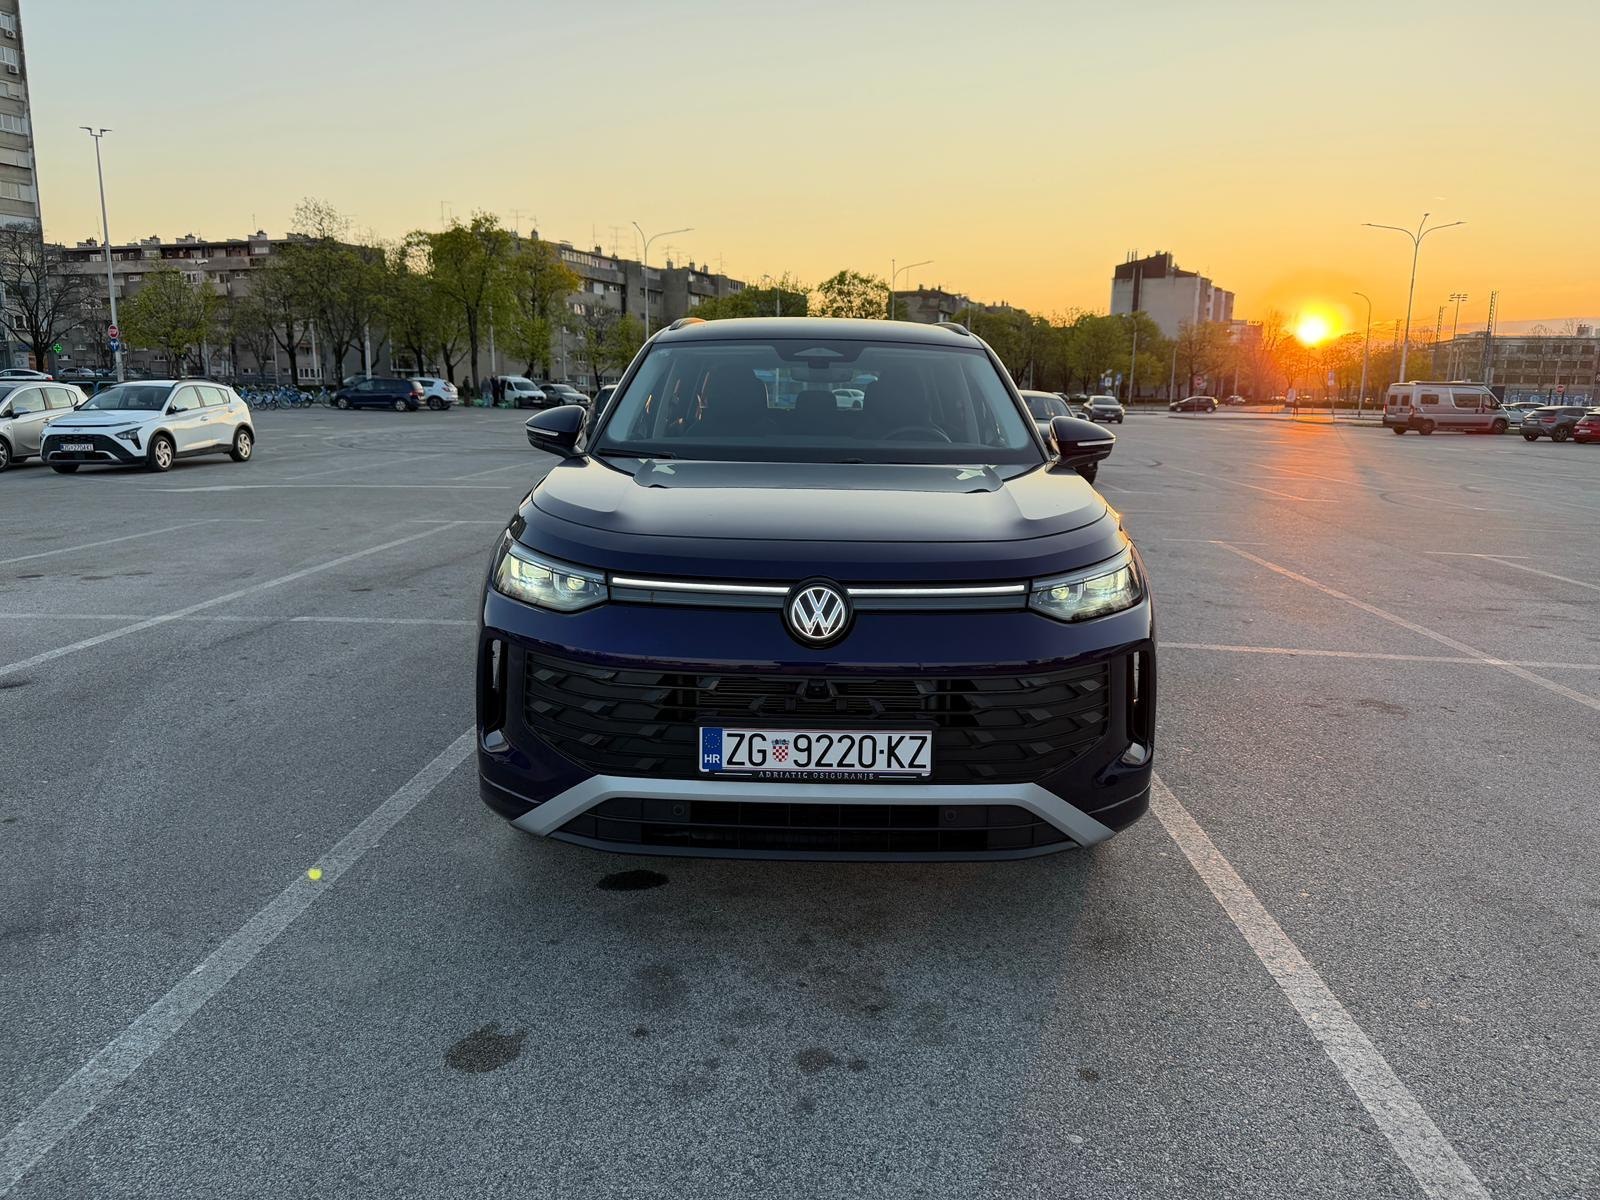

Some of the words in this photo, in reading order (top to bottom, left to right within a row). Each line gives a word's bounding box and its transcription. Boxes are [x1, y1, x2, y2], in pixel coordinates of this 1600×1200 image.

[704, 754, 720, 764] HR
[726, 733, 767, 767] ZG
[758, 771, 808, 779] ADRIATIC
[813, 772, 874, 780] OSIGURANJE
